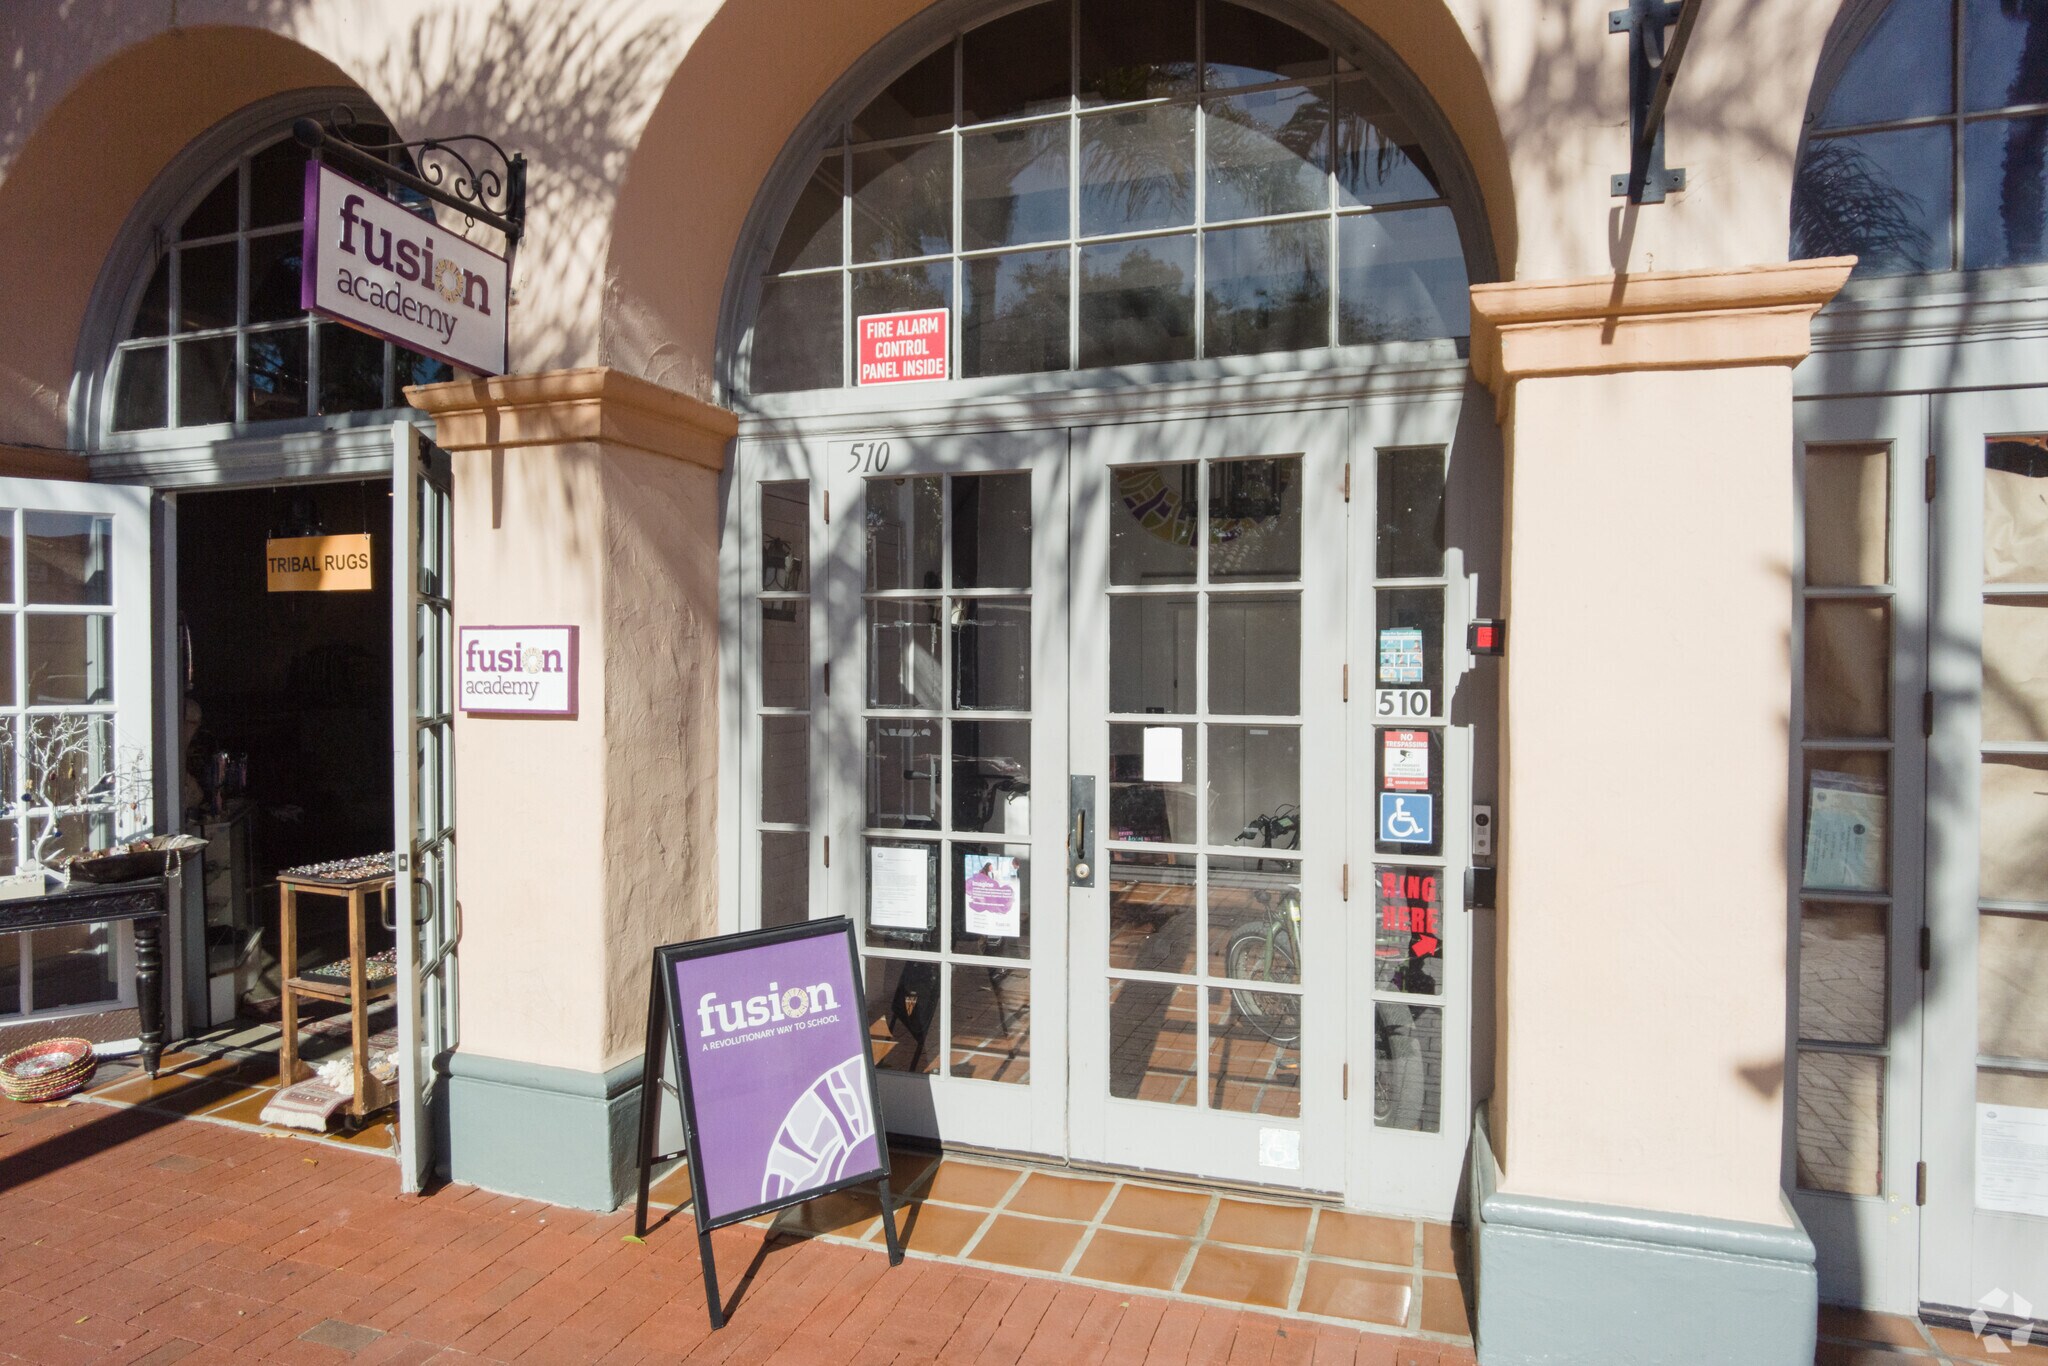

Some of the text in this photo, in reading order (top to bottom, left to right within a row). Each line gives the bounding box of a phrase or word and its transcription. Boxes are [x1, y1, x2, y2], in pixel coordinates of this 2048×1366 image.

[338, 194, 491, 316] fusion
[337, 267, 458, 345] academy
[867, 317, 939, 339] FIRE ALARM
[875, 338, 929, 359] CONTROL
[862, 358, 944, 380] PANEL INSIDE
[848, 441, 890, 473] 510
[268, 553, 369, 573] TRIBAL RUGS
[466, 639, 563, 674] fusion
[466, 675, 540, 701] academy
[1378, 690, 1428, 716] 510
[1386, 740, 1428, 748] TRESPASSING
[1400, 733, 1414, 741] NO
[1382, 872, 1437, 902] RING
[1382, 905, 1439, 934] HERE
[697, 982, 839, 1038] fusion
[702, 1014, 840, 1052] A REVOLUTIONARY WAY TO SCHOOL
